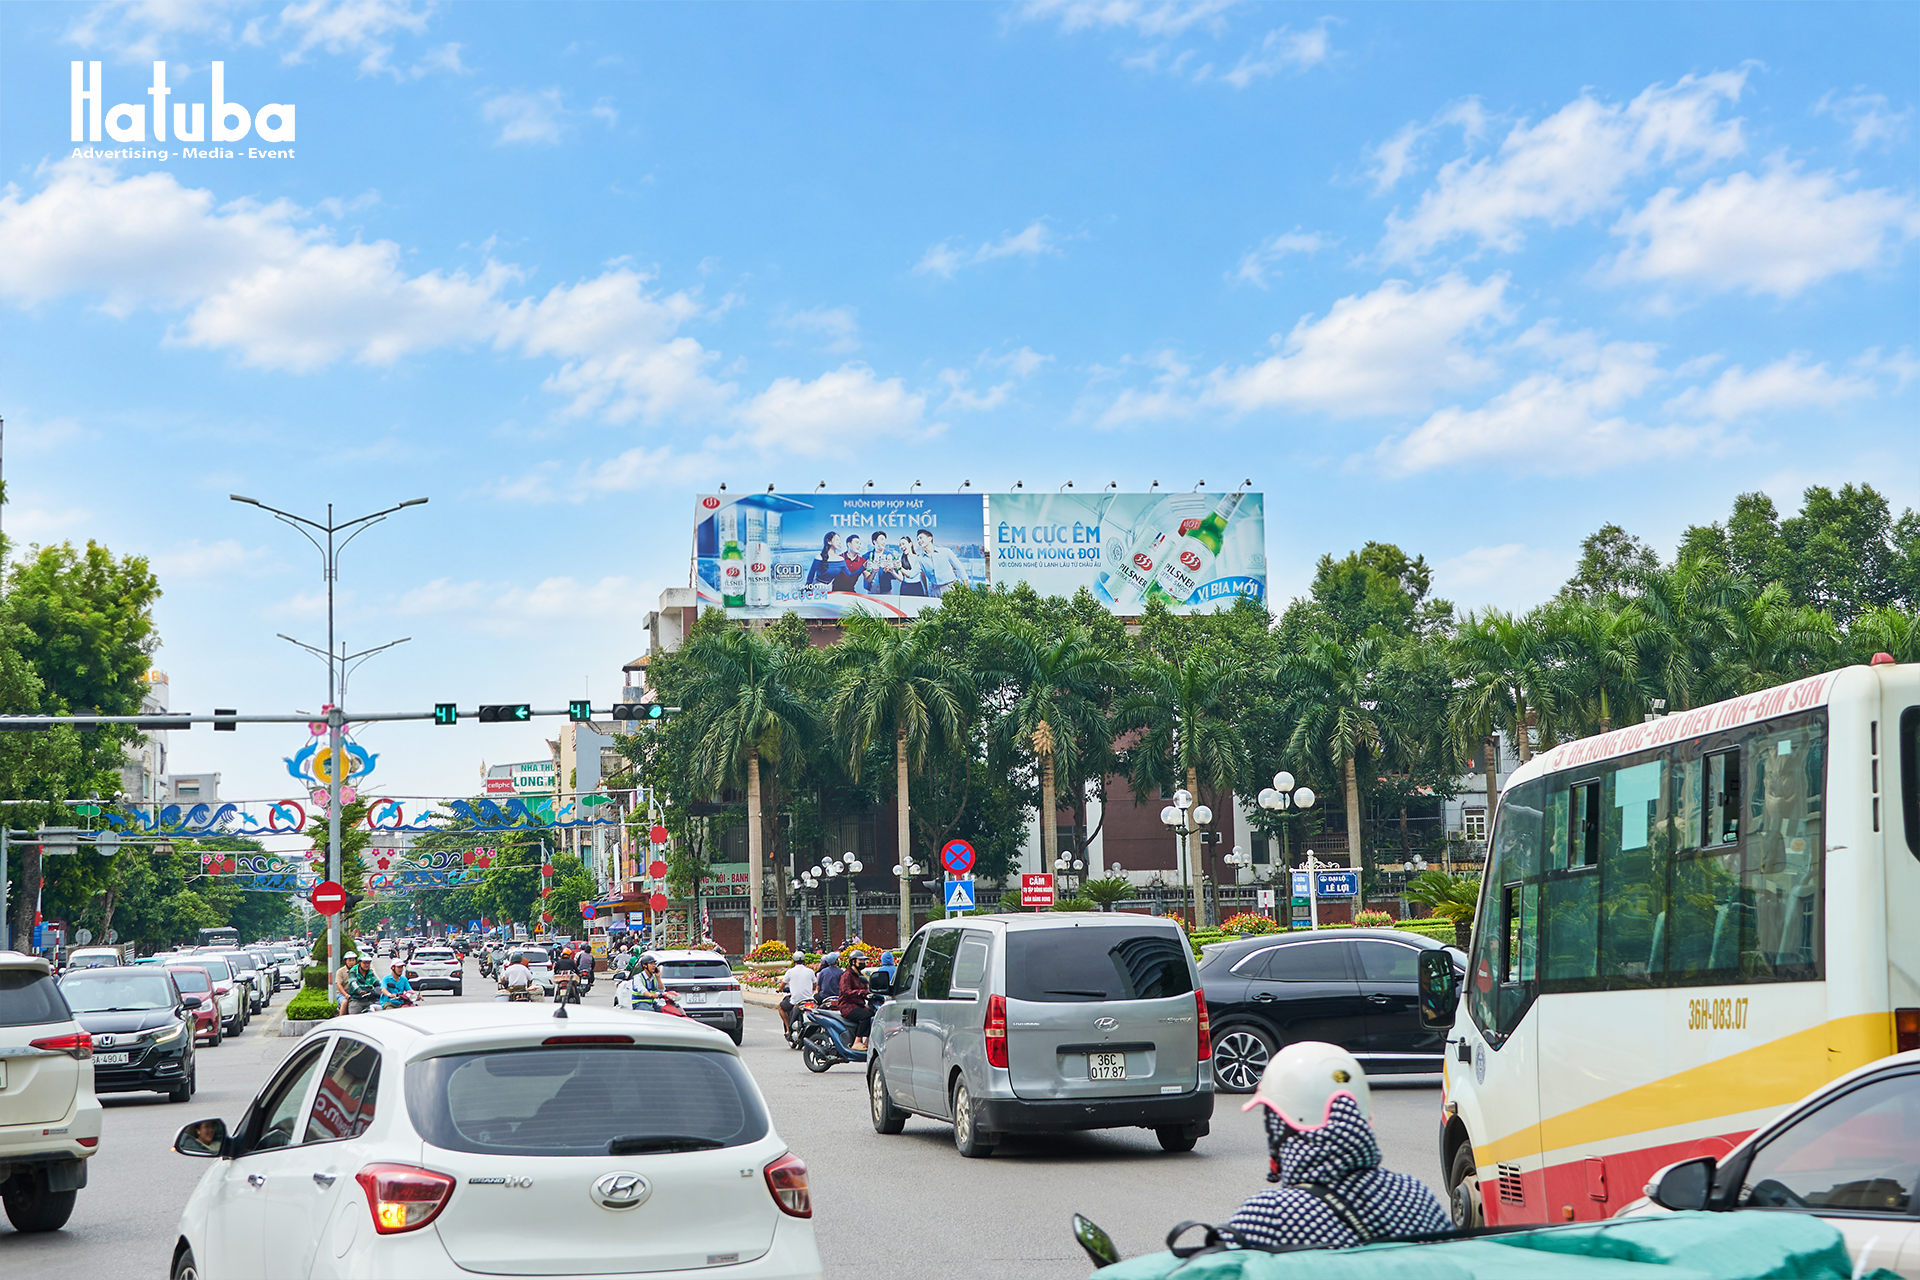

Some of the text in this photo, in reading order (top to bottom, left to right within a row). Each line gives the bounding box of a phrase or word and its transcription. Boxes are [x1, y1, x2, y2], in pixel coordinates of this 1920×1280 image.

[843, 499, 870, 508] MUÔN
[871, 500, 885, 509] DỊP
[830, 509, 937, 528] THÊM KẾT NỐI
[998, 521, 1101, 546] ÊM CỰC ÊM
[998, 545, 1100, 561] XỨNG MONG ĐỢI
[776, 565, 801, 575] COLD
[1119, 563, 1148, 588] PILSNER
[1164, 562, 1196, 590] PILSNER
[1197, 579, 1258, 601] VỊ BIA MỚI
[436, 706, 455, 722] 41
[570, 704, 590, 719] 41
[1554, 745, 1569, 767] 5
[513, 776, 543, 787] LONG
[731, 871, 748, 883] BÁNH
[1326, 883, 1349, 893] LÊ LỢI
[1688, 997, 1748, 1030] 36H-083.07
[1097, 1054, 1116, 1066] 36C
[1091, 1066, 1124, 1079] 017.87
